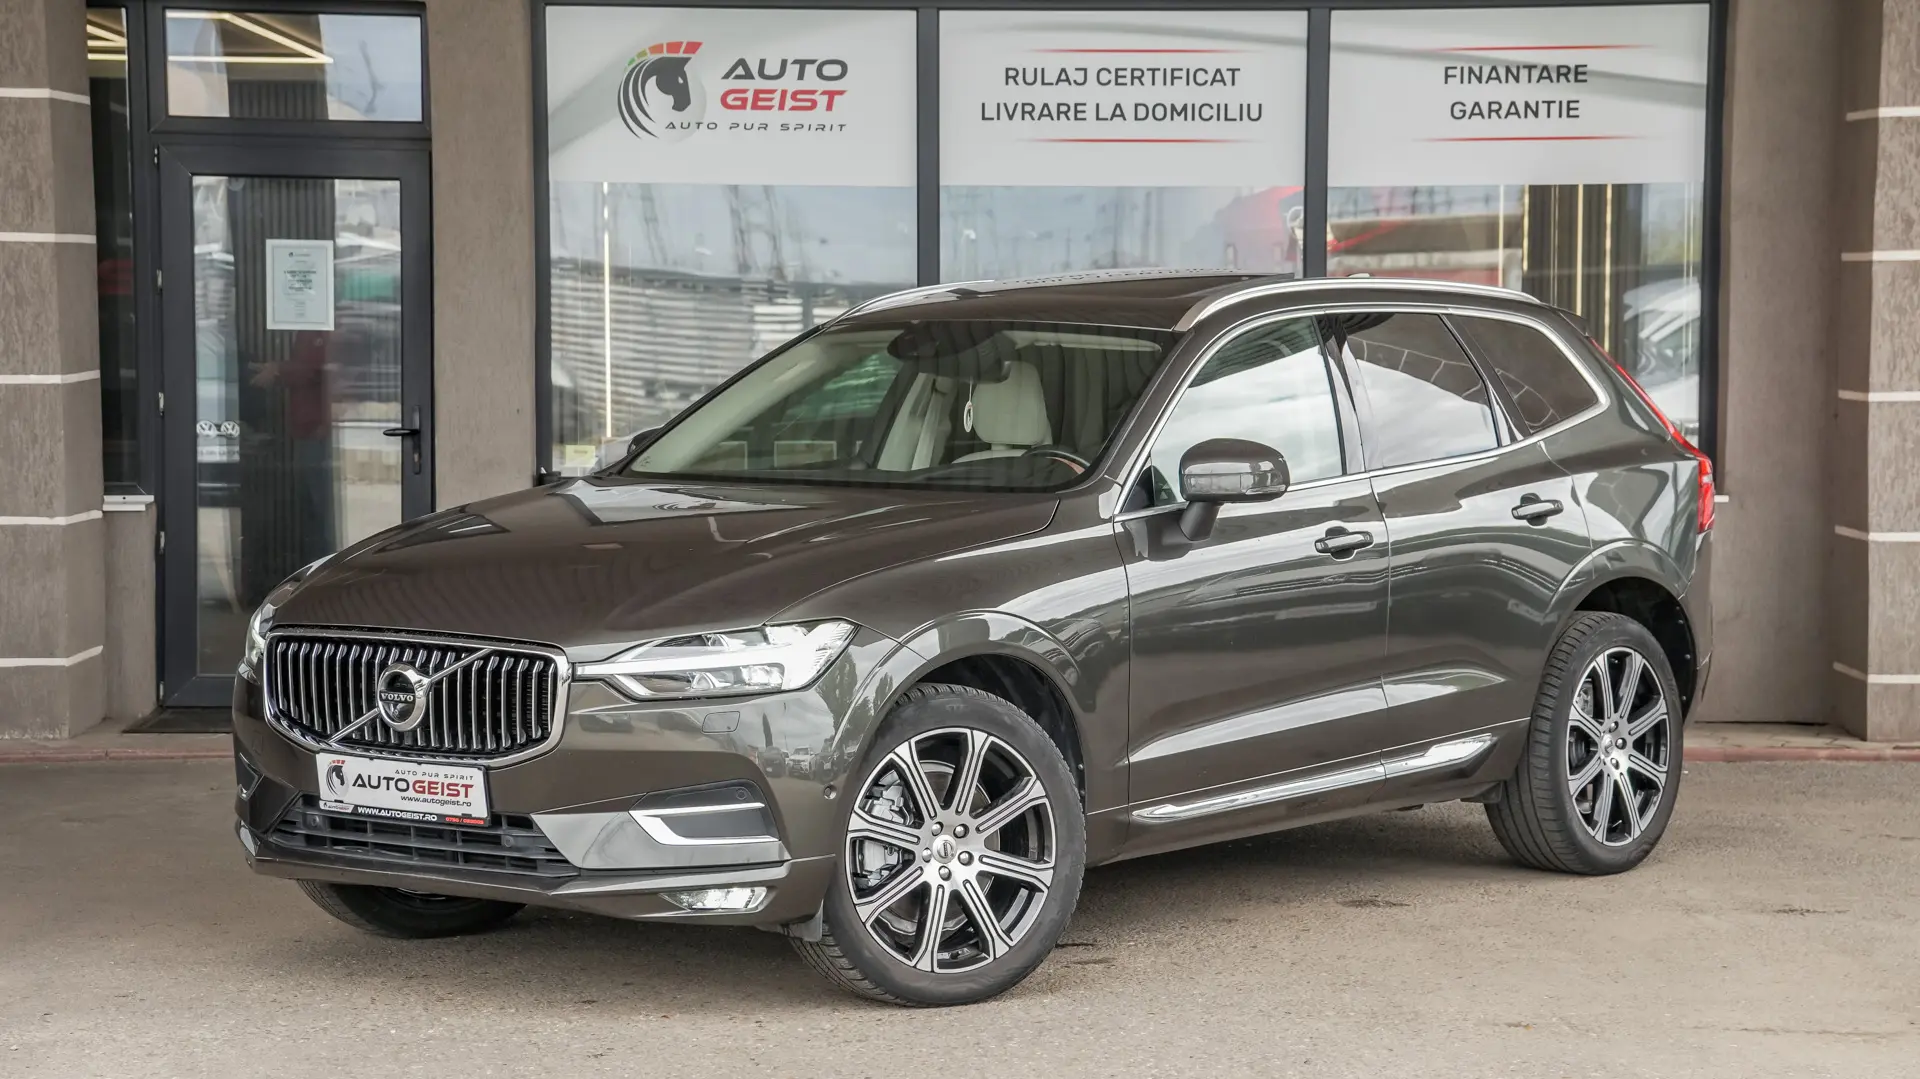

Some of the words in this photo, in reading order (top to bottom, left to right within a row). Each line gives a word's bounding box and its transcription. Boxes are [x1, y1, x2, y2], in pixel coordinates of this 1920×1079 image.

[721, 57, 848, 81] AUTO
[1005, 67, 1088, 86] RULAJ
[1096, 67, 1241, 86] CERTIFICAT
[1444, 64, 1588, 84] FINANTARE
[720, 88, 848, 112] GEIST
[1450, 100, 1580, 119] GARANTIE
[981, 102, 1087, 121] LIVRARE
[1096, 102, 1127, 121] LA
[1134, 103, 1263, 122] DOMICILIU
[665, 121, 718, 130] AUTO
[729, 122, 768, 131] PUR
[780, 123, 847, 132] SPIRIT
[381, 692, 414, 702] VOLVO
[443, 773, 474, 781] SPIRIT
[400, 795, 472, 807] www.autogeist.ro
[357, 806, 438, 822] WWW.AUTOGEIST.RO
